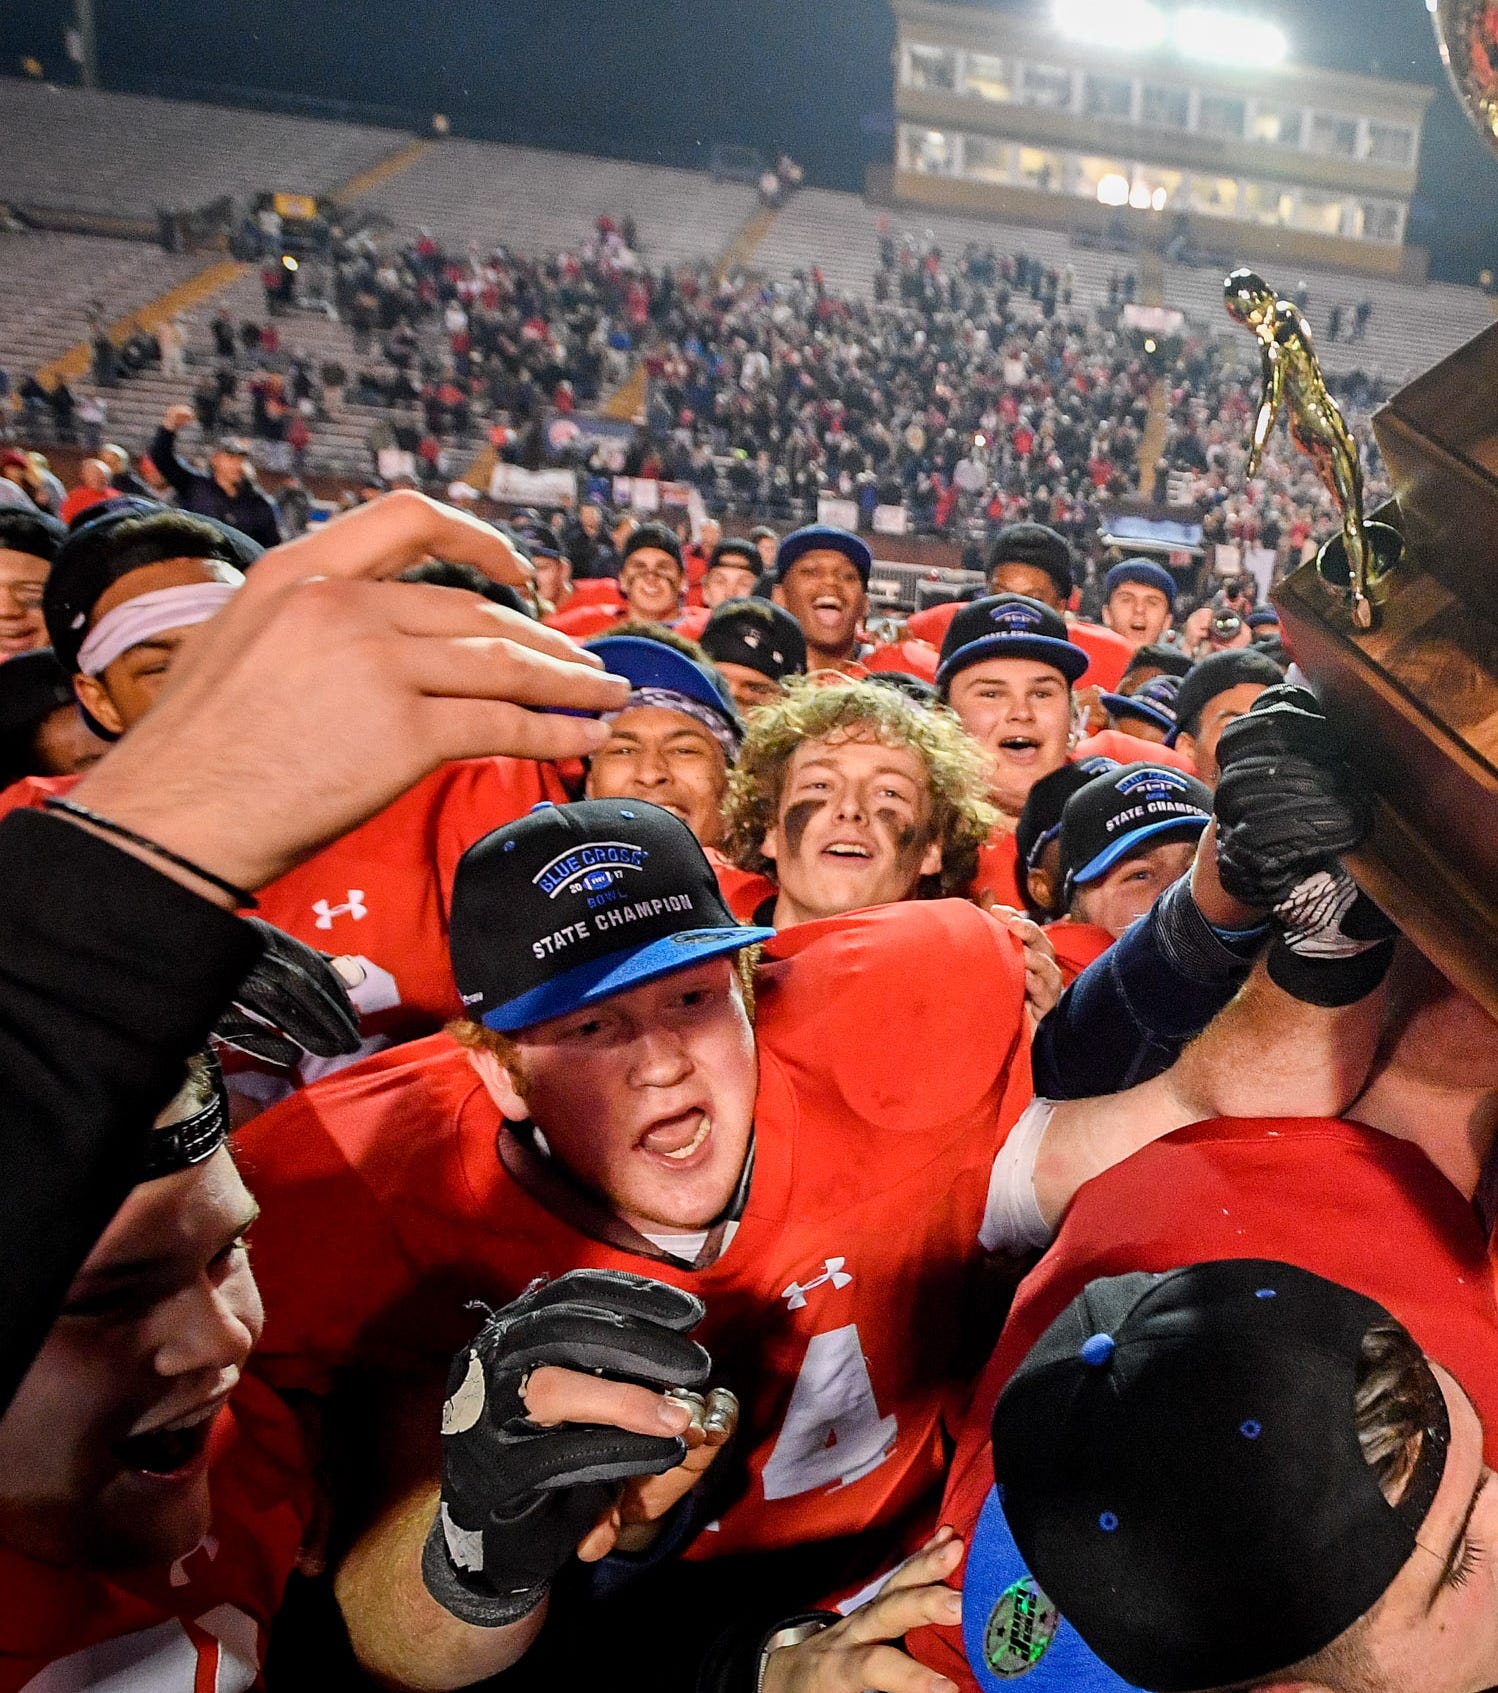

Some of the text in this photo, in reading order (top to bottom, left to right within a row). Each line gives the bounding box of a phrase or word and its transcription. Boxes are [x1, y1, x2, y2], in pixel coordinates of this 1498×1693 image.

[1105, 805, 1144, 832] STATE
[538, 847, 642, 893] BLUE CROSS
[586, 889, 628, 909] BOWL
[531, 894, 693, 960] STATE CHAMPION
